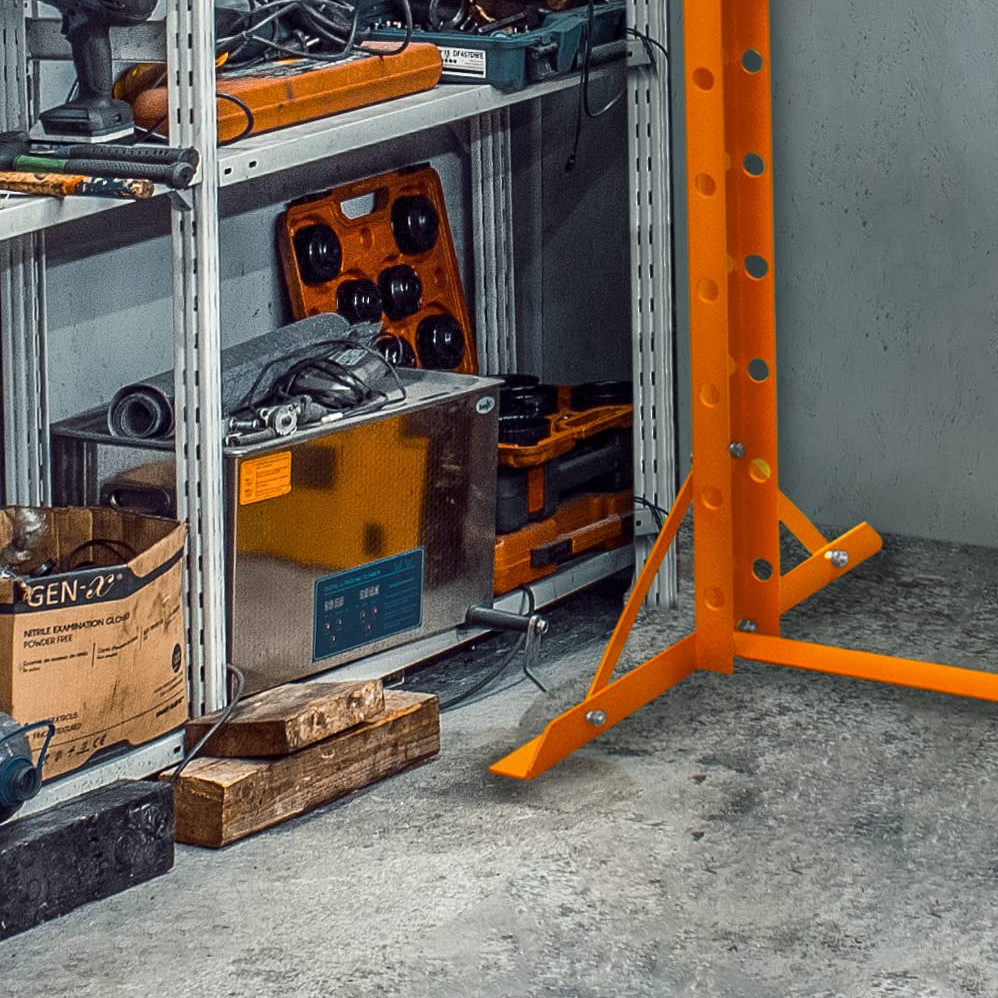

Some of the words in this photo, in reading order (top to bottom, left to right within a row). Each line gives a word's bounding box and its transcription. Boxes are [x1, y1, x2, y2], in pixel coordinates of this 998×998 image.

[23, 627, 51, 638] NITRILE
[52, 618, 104, 634] EXAMINATION
[23, 637, 55, 650] POWDER
[57, 634, 73, 644] FREE
